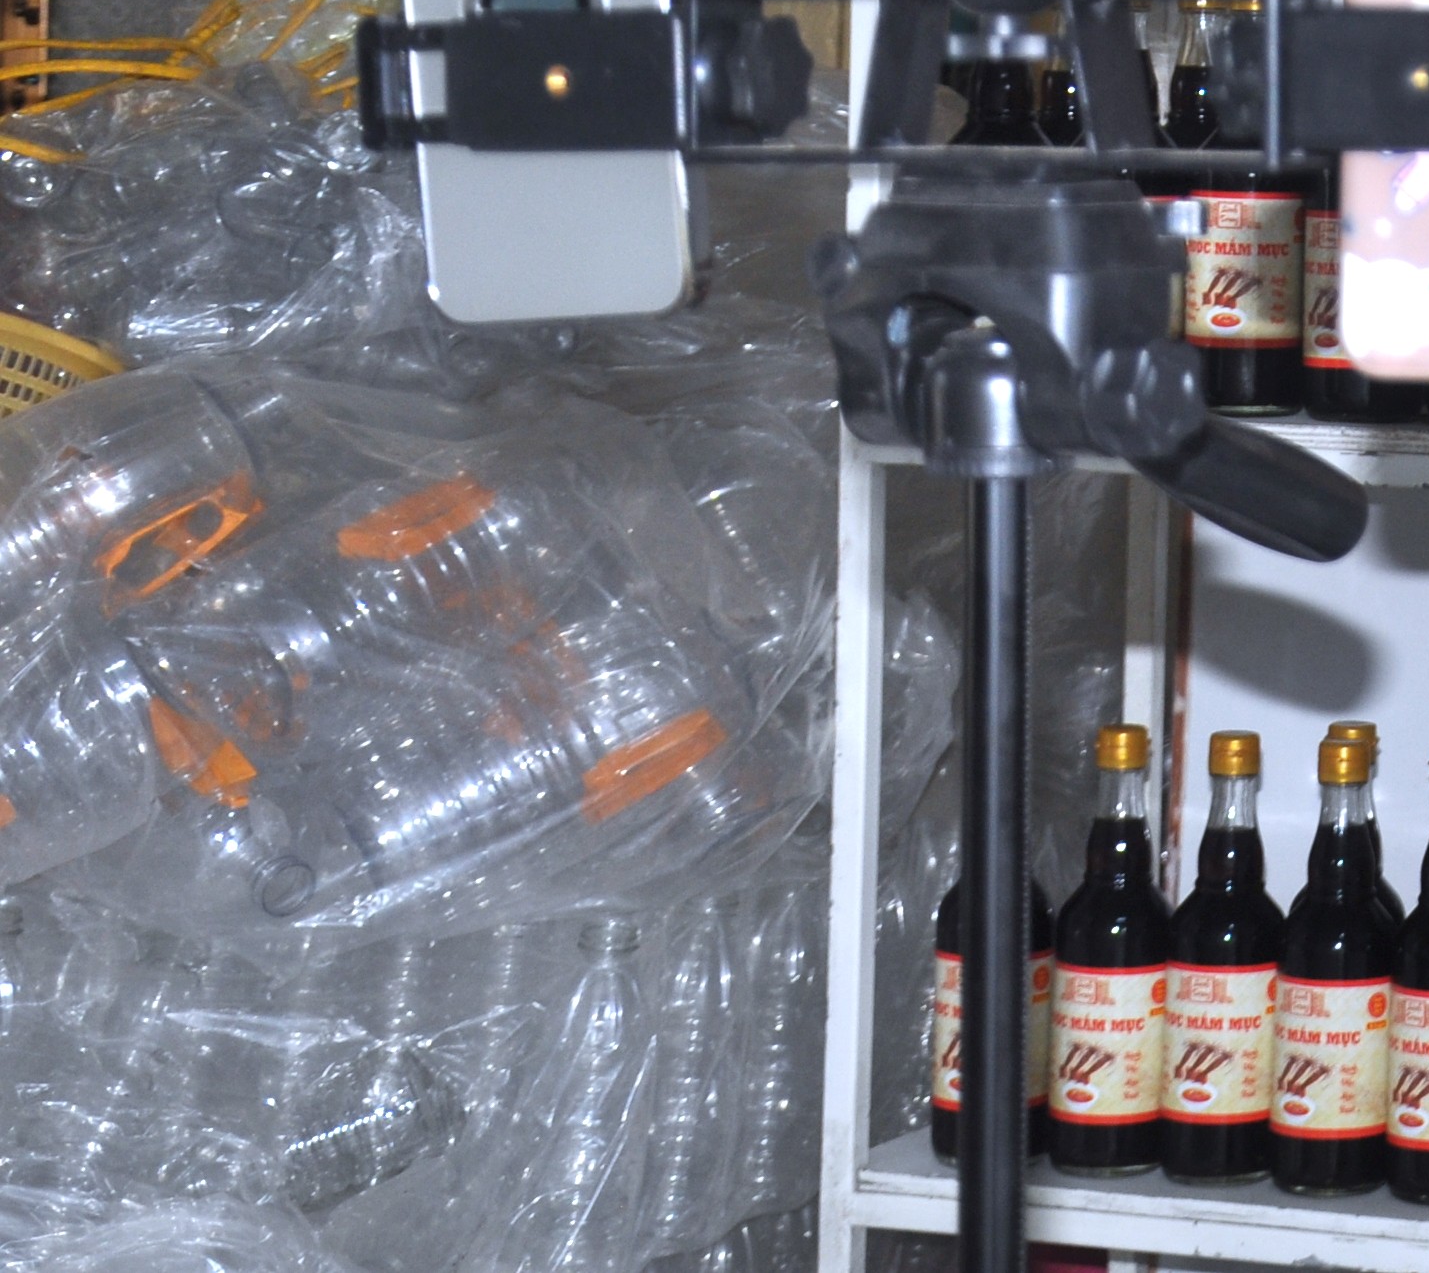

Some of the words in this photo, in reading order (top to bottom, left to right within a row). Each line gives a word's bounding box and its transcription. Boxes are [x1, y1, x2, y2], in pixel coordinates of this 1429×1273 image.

[1257, 243, 1290, 259] MỤC
[1111, 1017, 1145, 1036] MỤC
[1228, 1015, 1262, 1032] MỤC
[1326, 1031, 1361, 1047] MỤC
